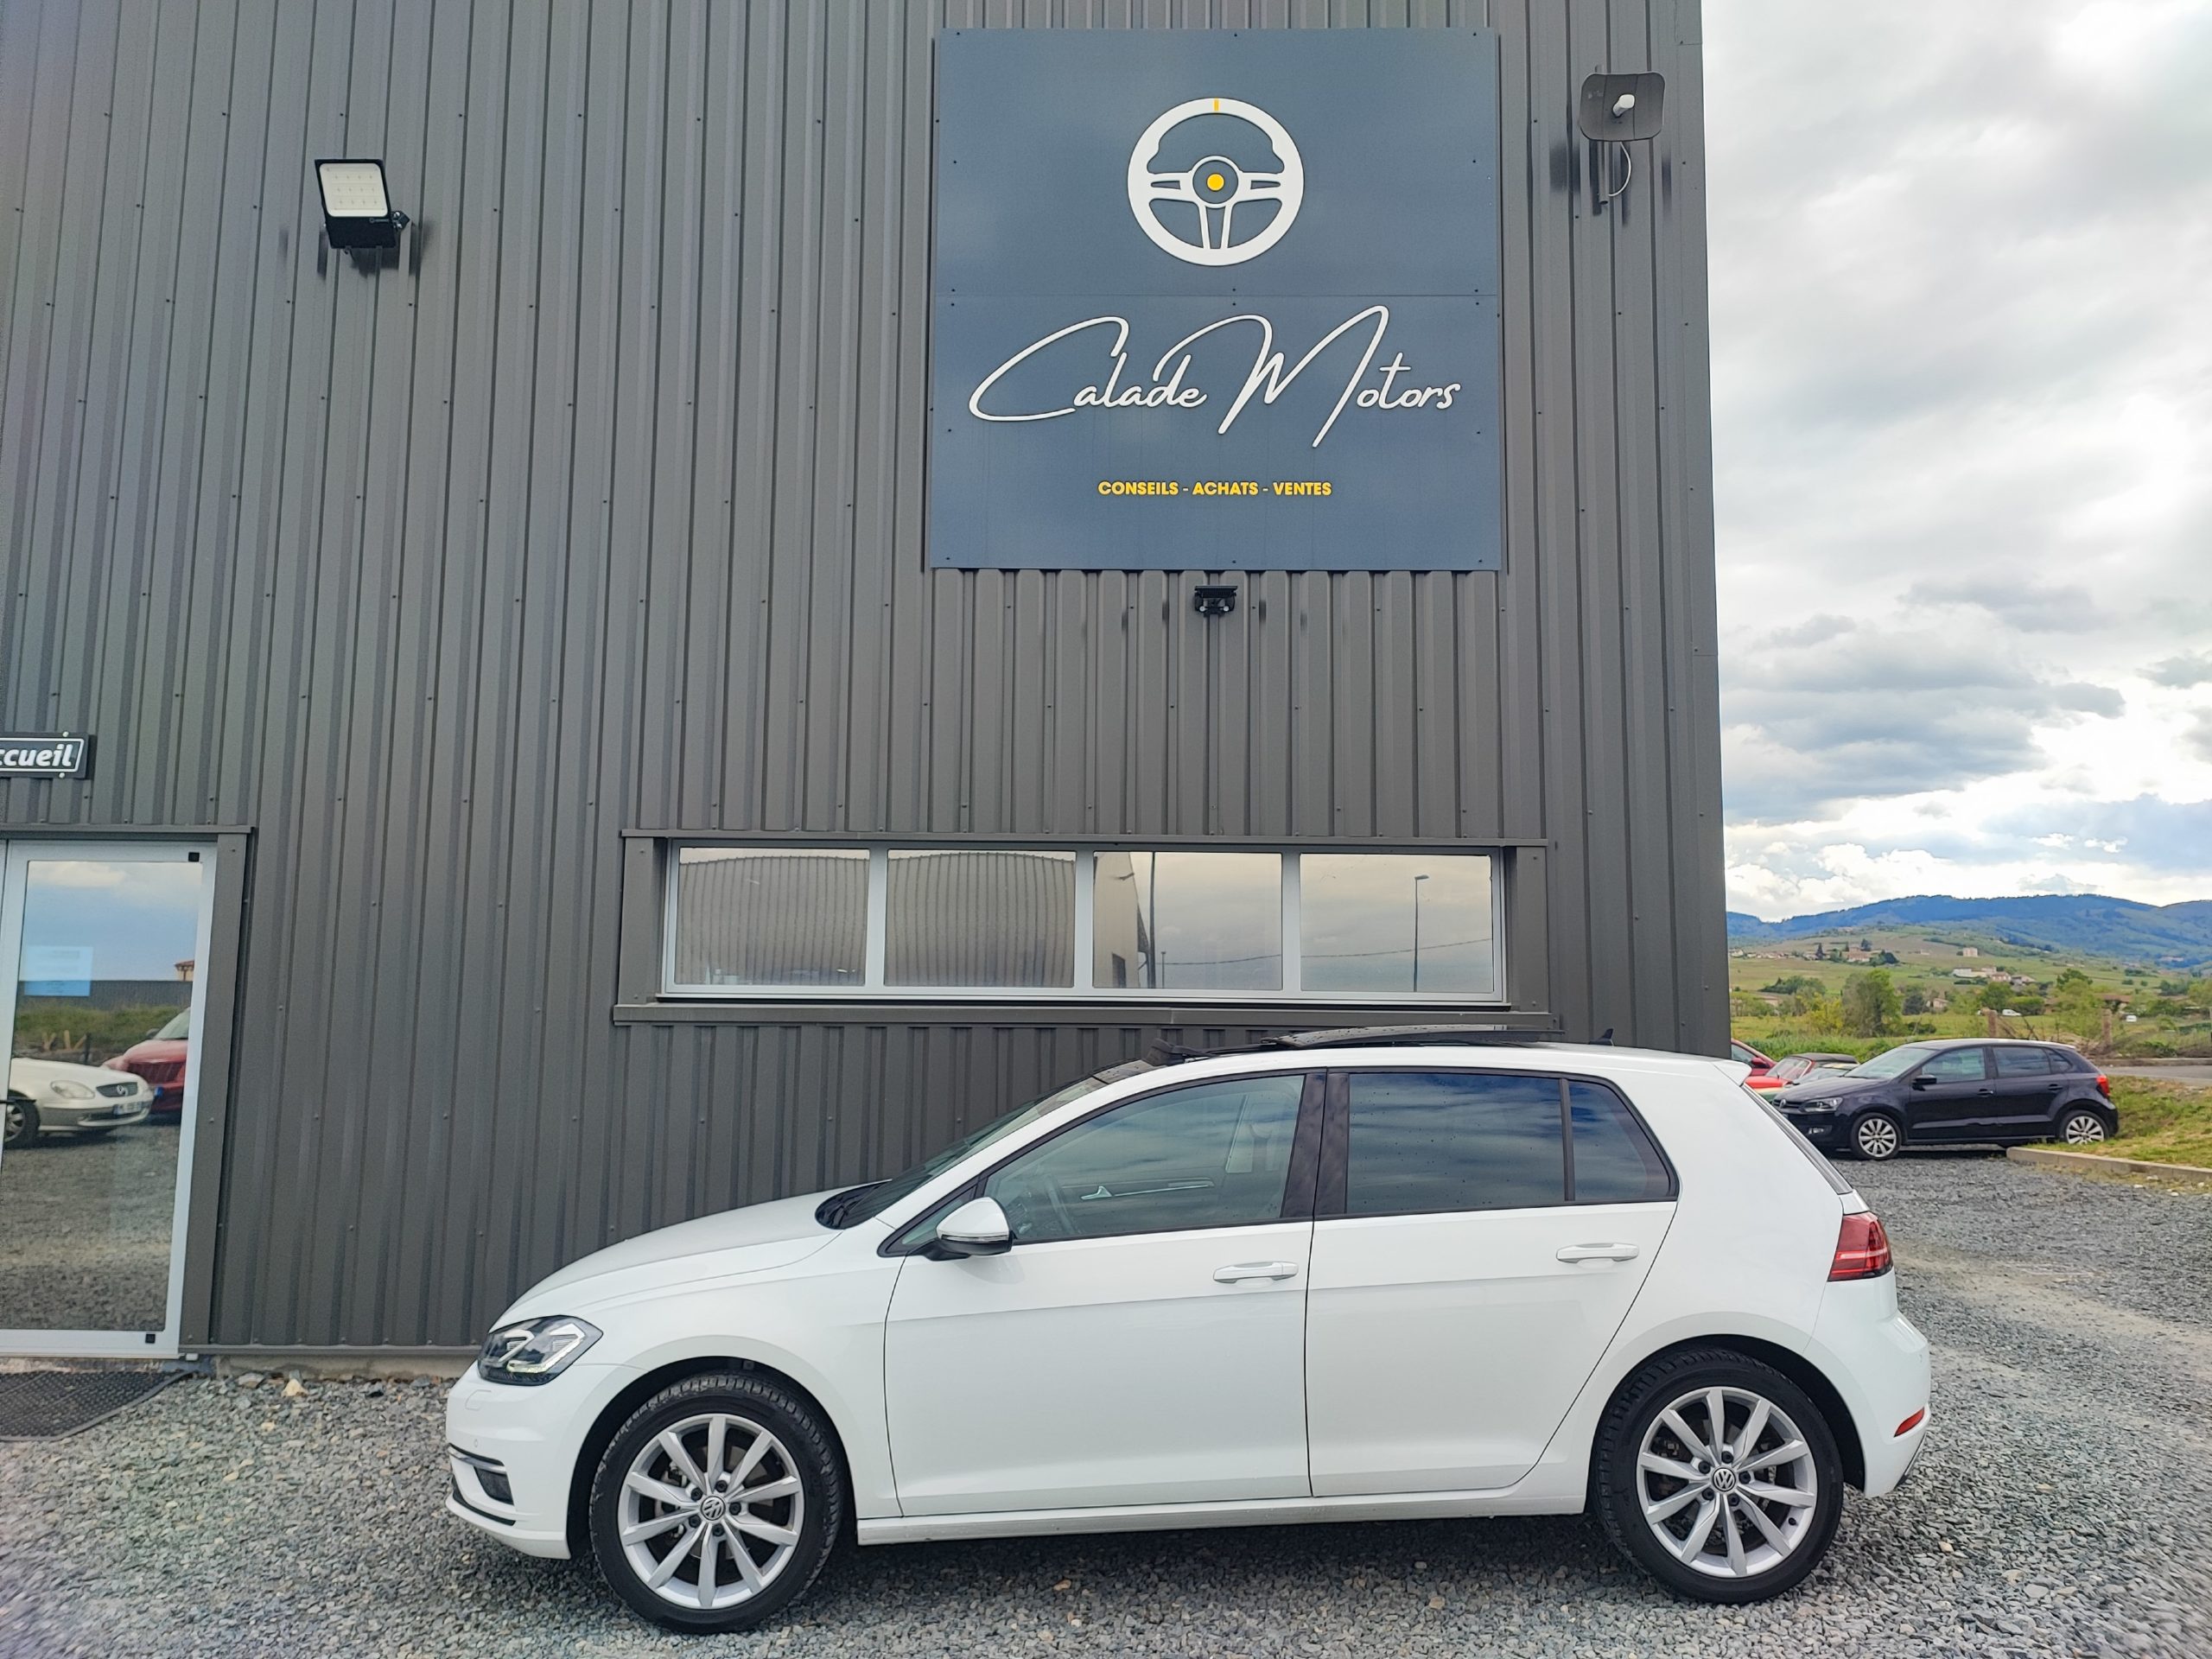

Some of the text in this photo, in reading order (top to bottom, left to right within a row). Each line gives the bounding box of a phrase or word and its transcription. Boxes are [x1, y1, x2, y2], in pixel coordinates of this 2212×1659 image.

[969, 305, 1462, 448] Calade Motors
[1097, 480, 1179, 496] CONSEILS
[1192, 481, 1259, 496] ACHATS
[1272, 481, 1332, 496] VENTES
